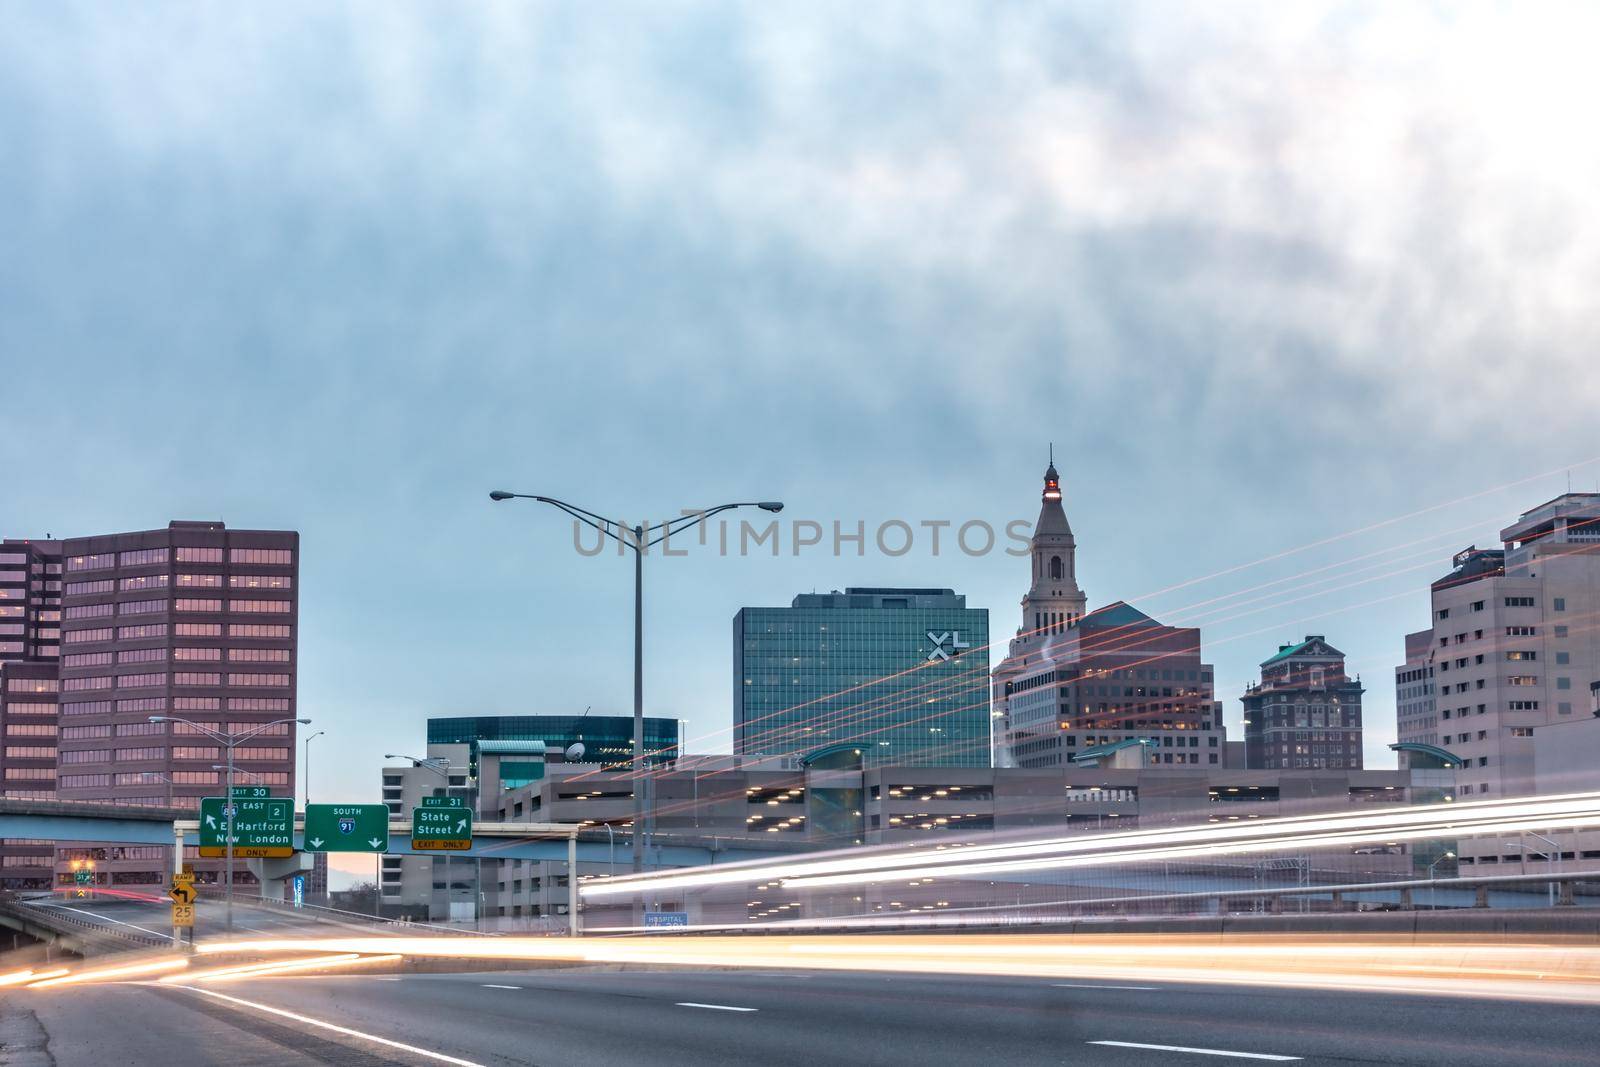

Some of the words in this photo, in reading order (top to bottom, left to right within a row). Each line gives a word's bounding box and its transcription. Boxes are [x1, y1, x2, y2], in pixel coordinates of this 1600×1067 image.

[927, 631, 970, 661] XL
[253, 788, 266, 797] 30
[242, 802, 265, 810] EAST
[450, 798, 461, 806] 31
[273, 808, 280, 816] 2
[333, 808, 362, 816] SOUTH
[421, 812, 450, 821] State
[236, 822, 286, 831] Hartford
[341, 823, 352, 831] 91
[418, 825, 452, 834] Street
[249, 834, 289, 843] London
[175, 906, 191, 918] 25
